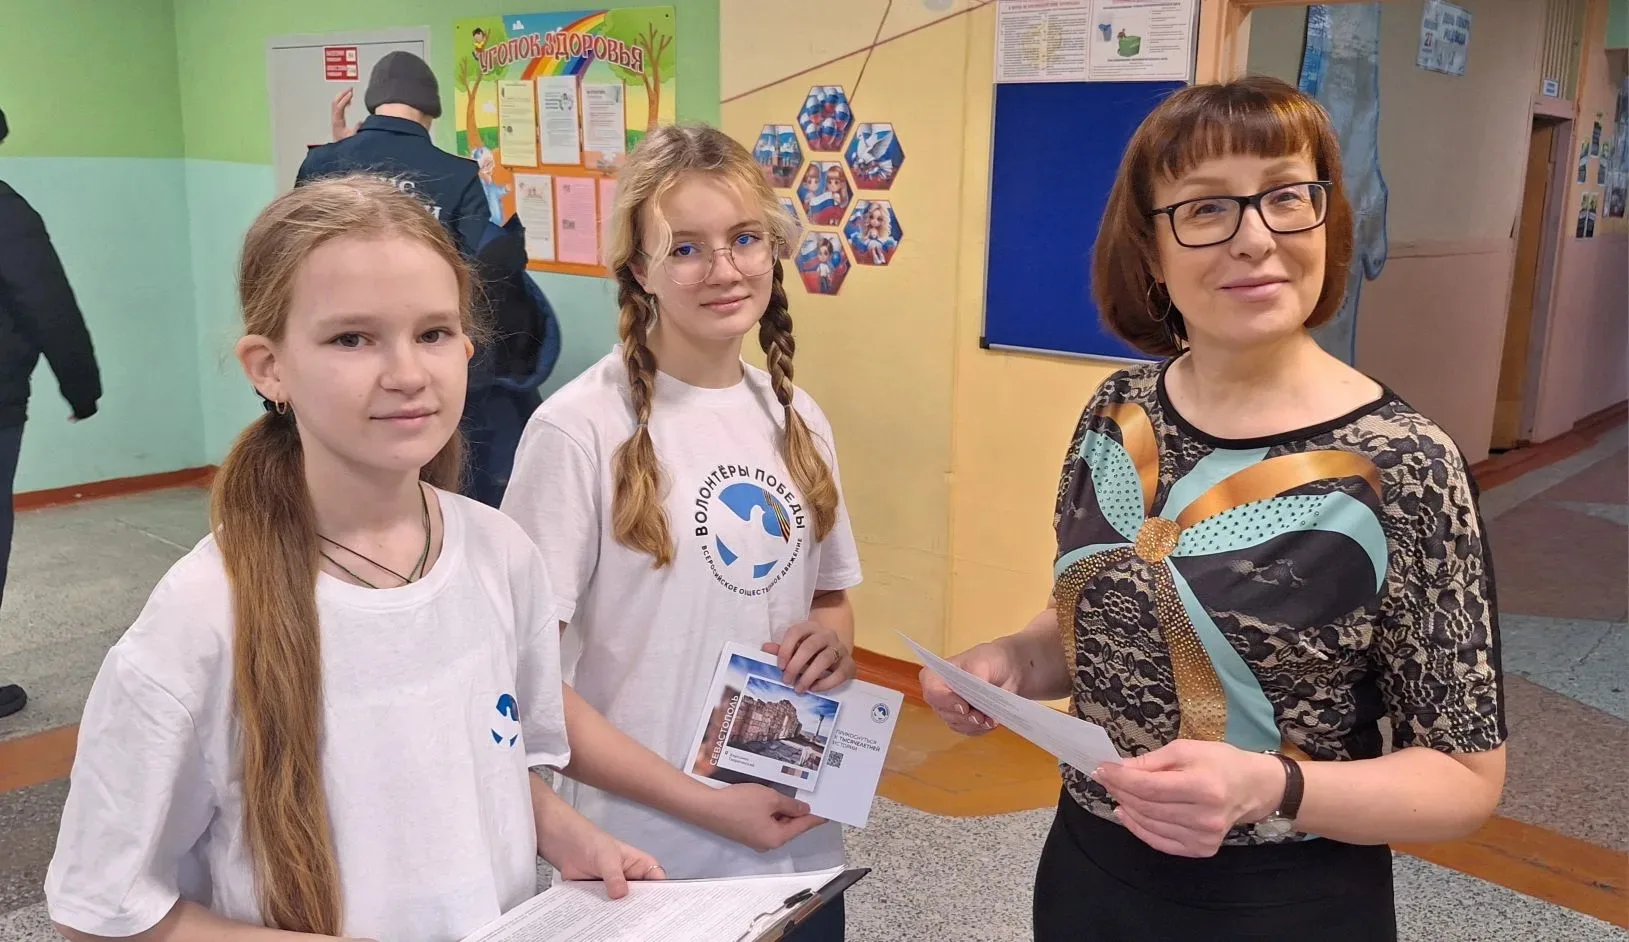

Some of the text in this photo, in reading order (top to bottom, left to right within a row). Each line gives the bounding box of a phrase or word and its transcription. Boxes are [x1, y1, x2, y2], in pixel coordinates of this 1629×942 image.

[544, 31, 645, 74] ЗДОРОВЬЯ
[694, 464, 806, 537] ВОЛОНТЁРЫ ПОБЕДЫ
[780, 537, 803, 577] ДВИЖЕНИЕ
[709, 695, 739, 766] СЕВАСТОПОЛЬ
